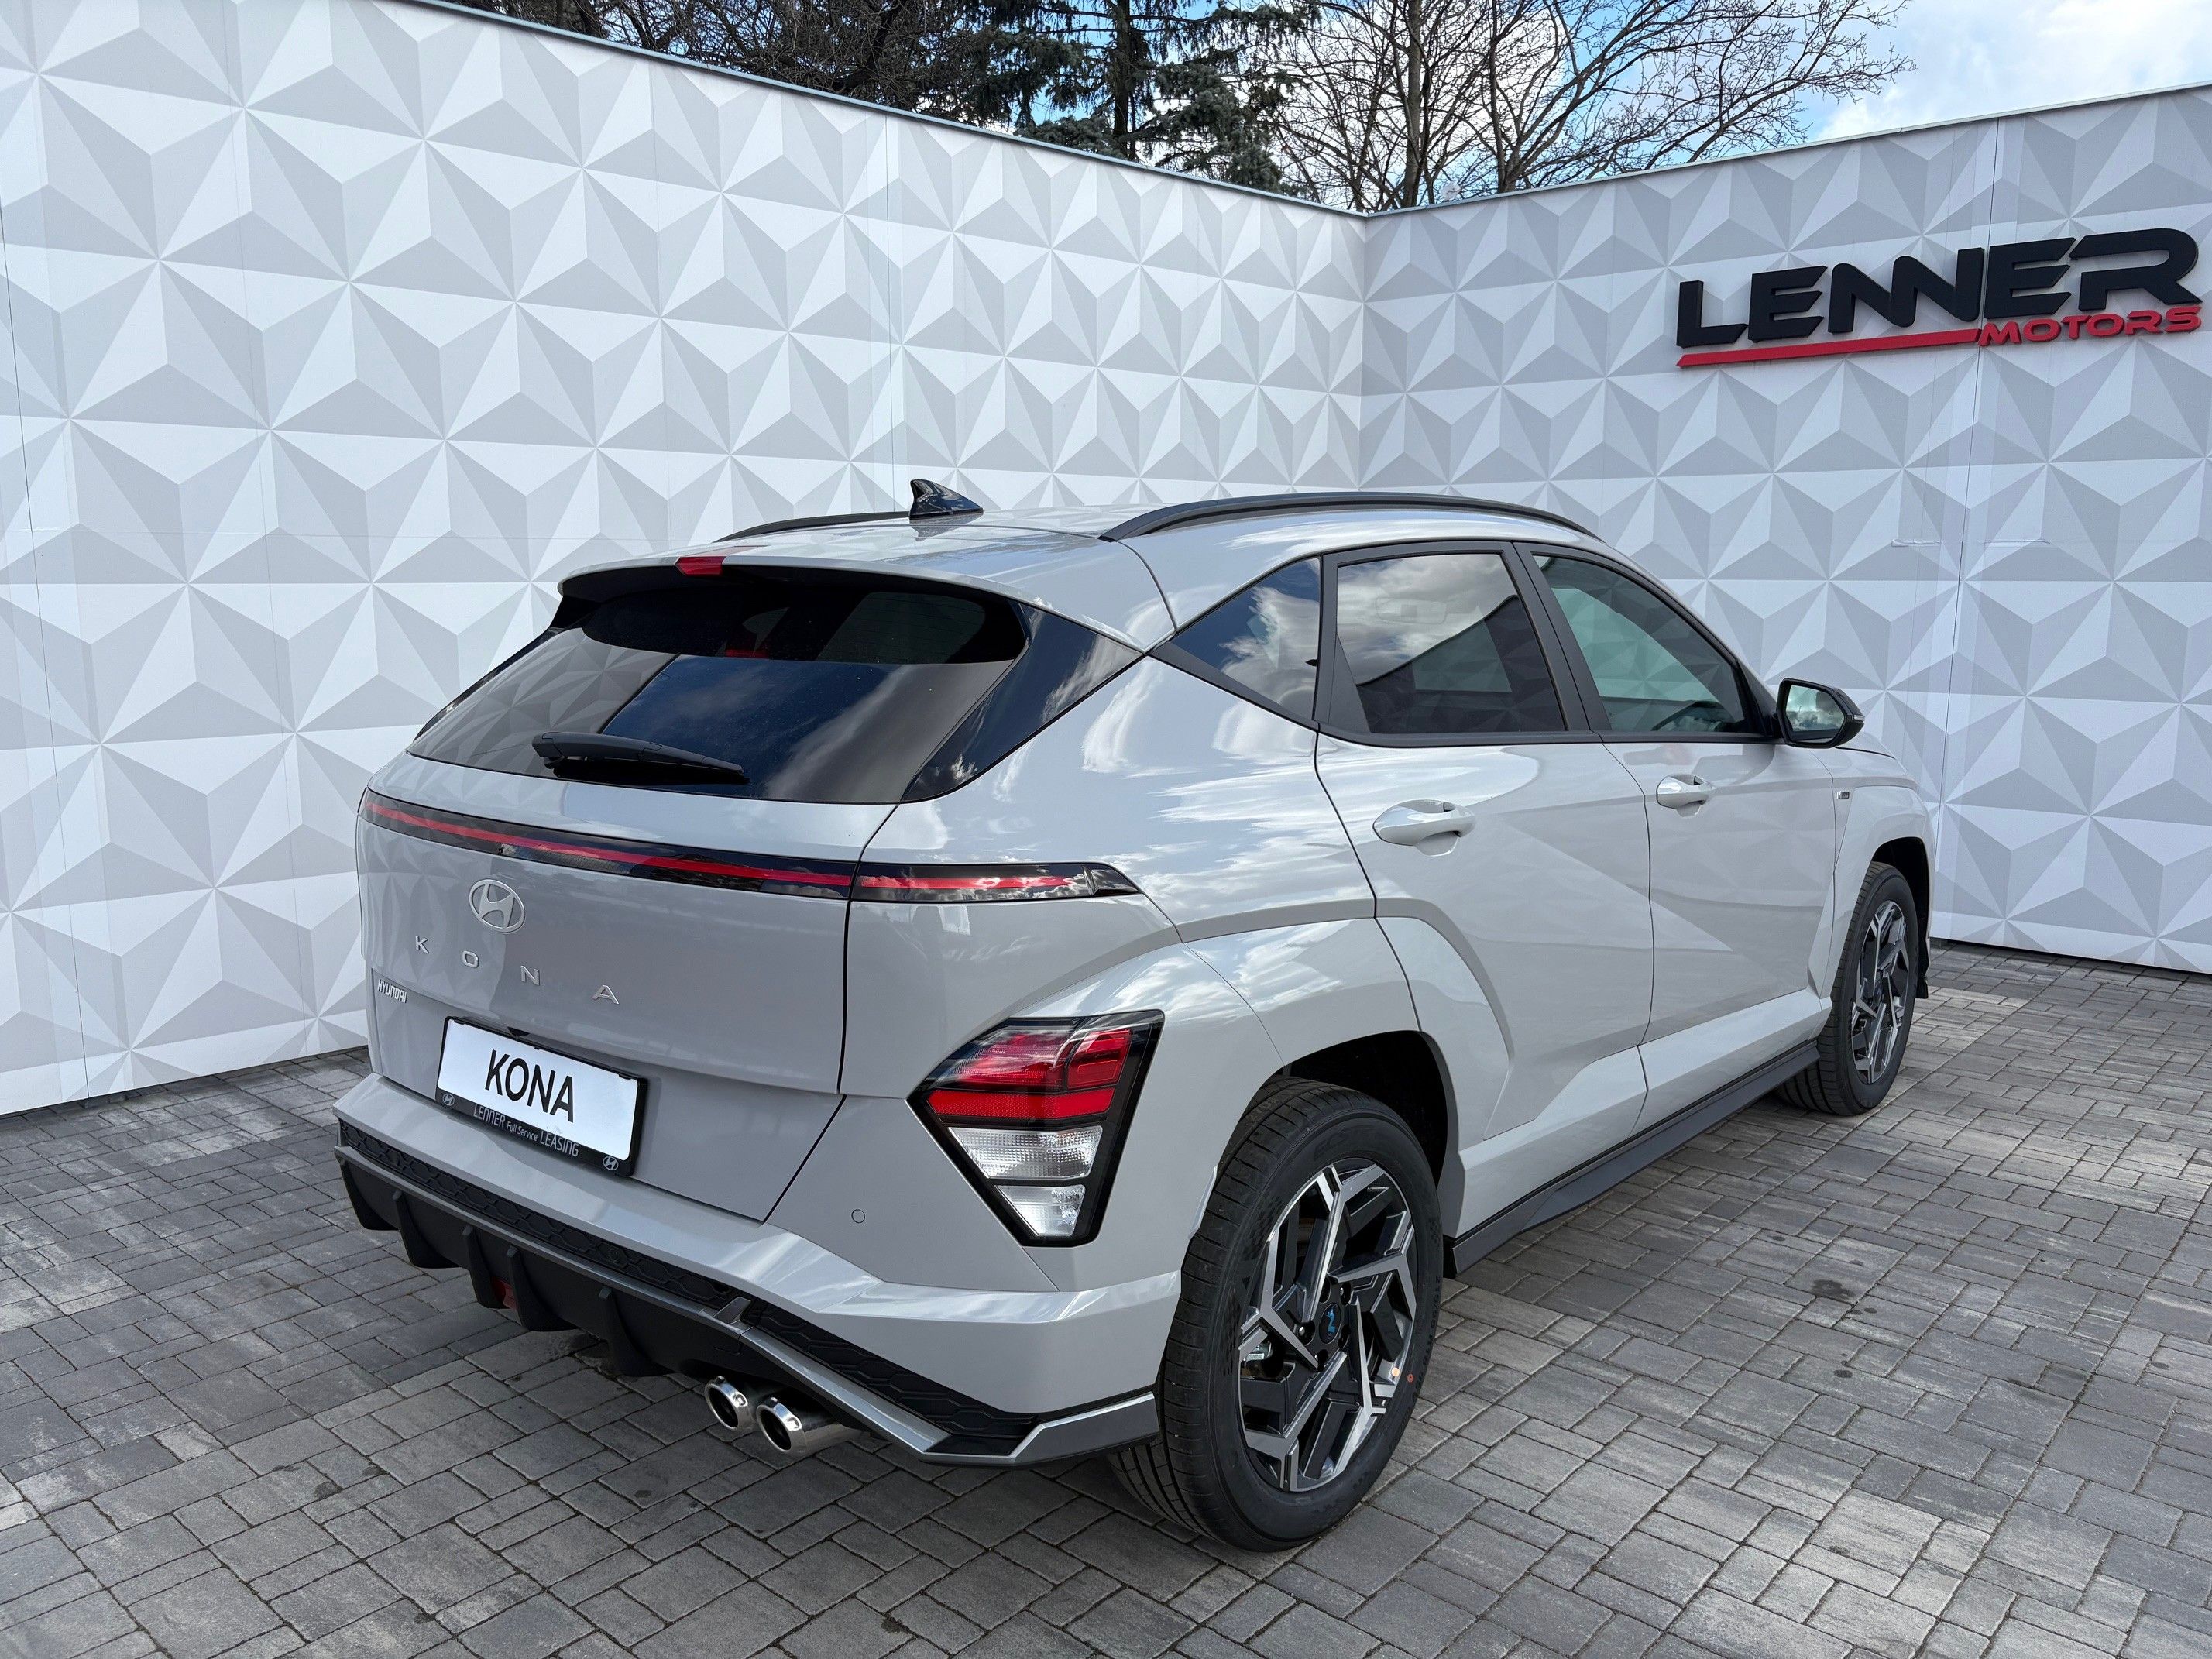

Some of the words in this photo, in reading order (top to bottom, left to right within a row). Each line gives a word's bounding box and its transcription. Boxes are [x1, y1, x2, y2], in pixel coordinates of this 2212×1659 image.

[1676, 228, 2203, 349] LENNER
[1978, 305, 2202, 348] MOTORS
[377, 979, 407, 1003] HYUNDAI
[415, 935, 620, 1005] KONA
[485, 1049, 575, 1123] KONA
[473, 1104, 506, 1128] LENNER
[507, 1121, 517, 1133] Full
[517, 1125, 538, 1142] Service
[540, 1131, 579, 1157] LEASING
